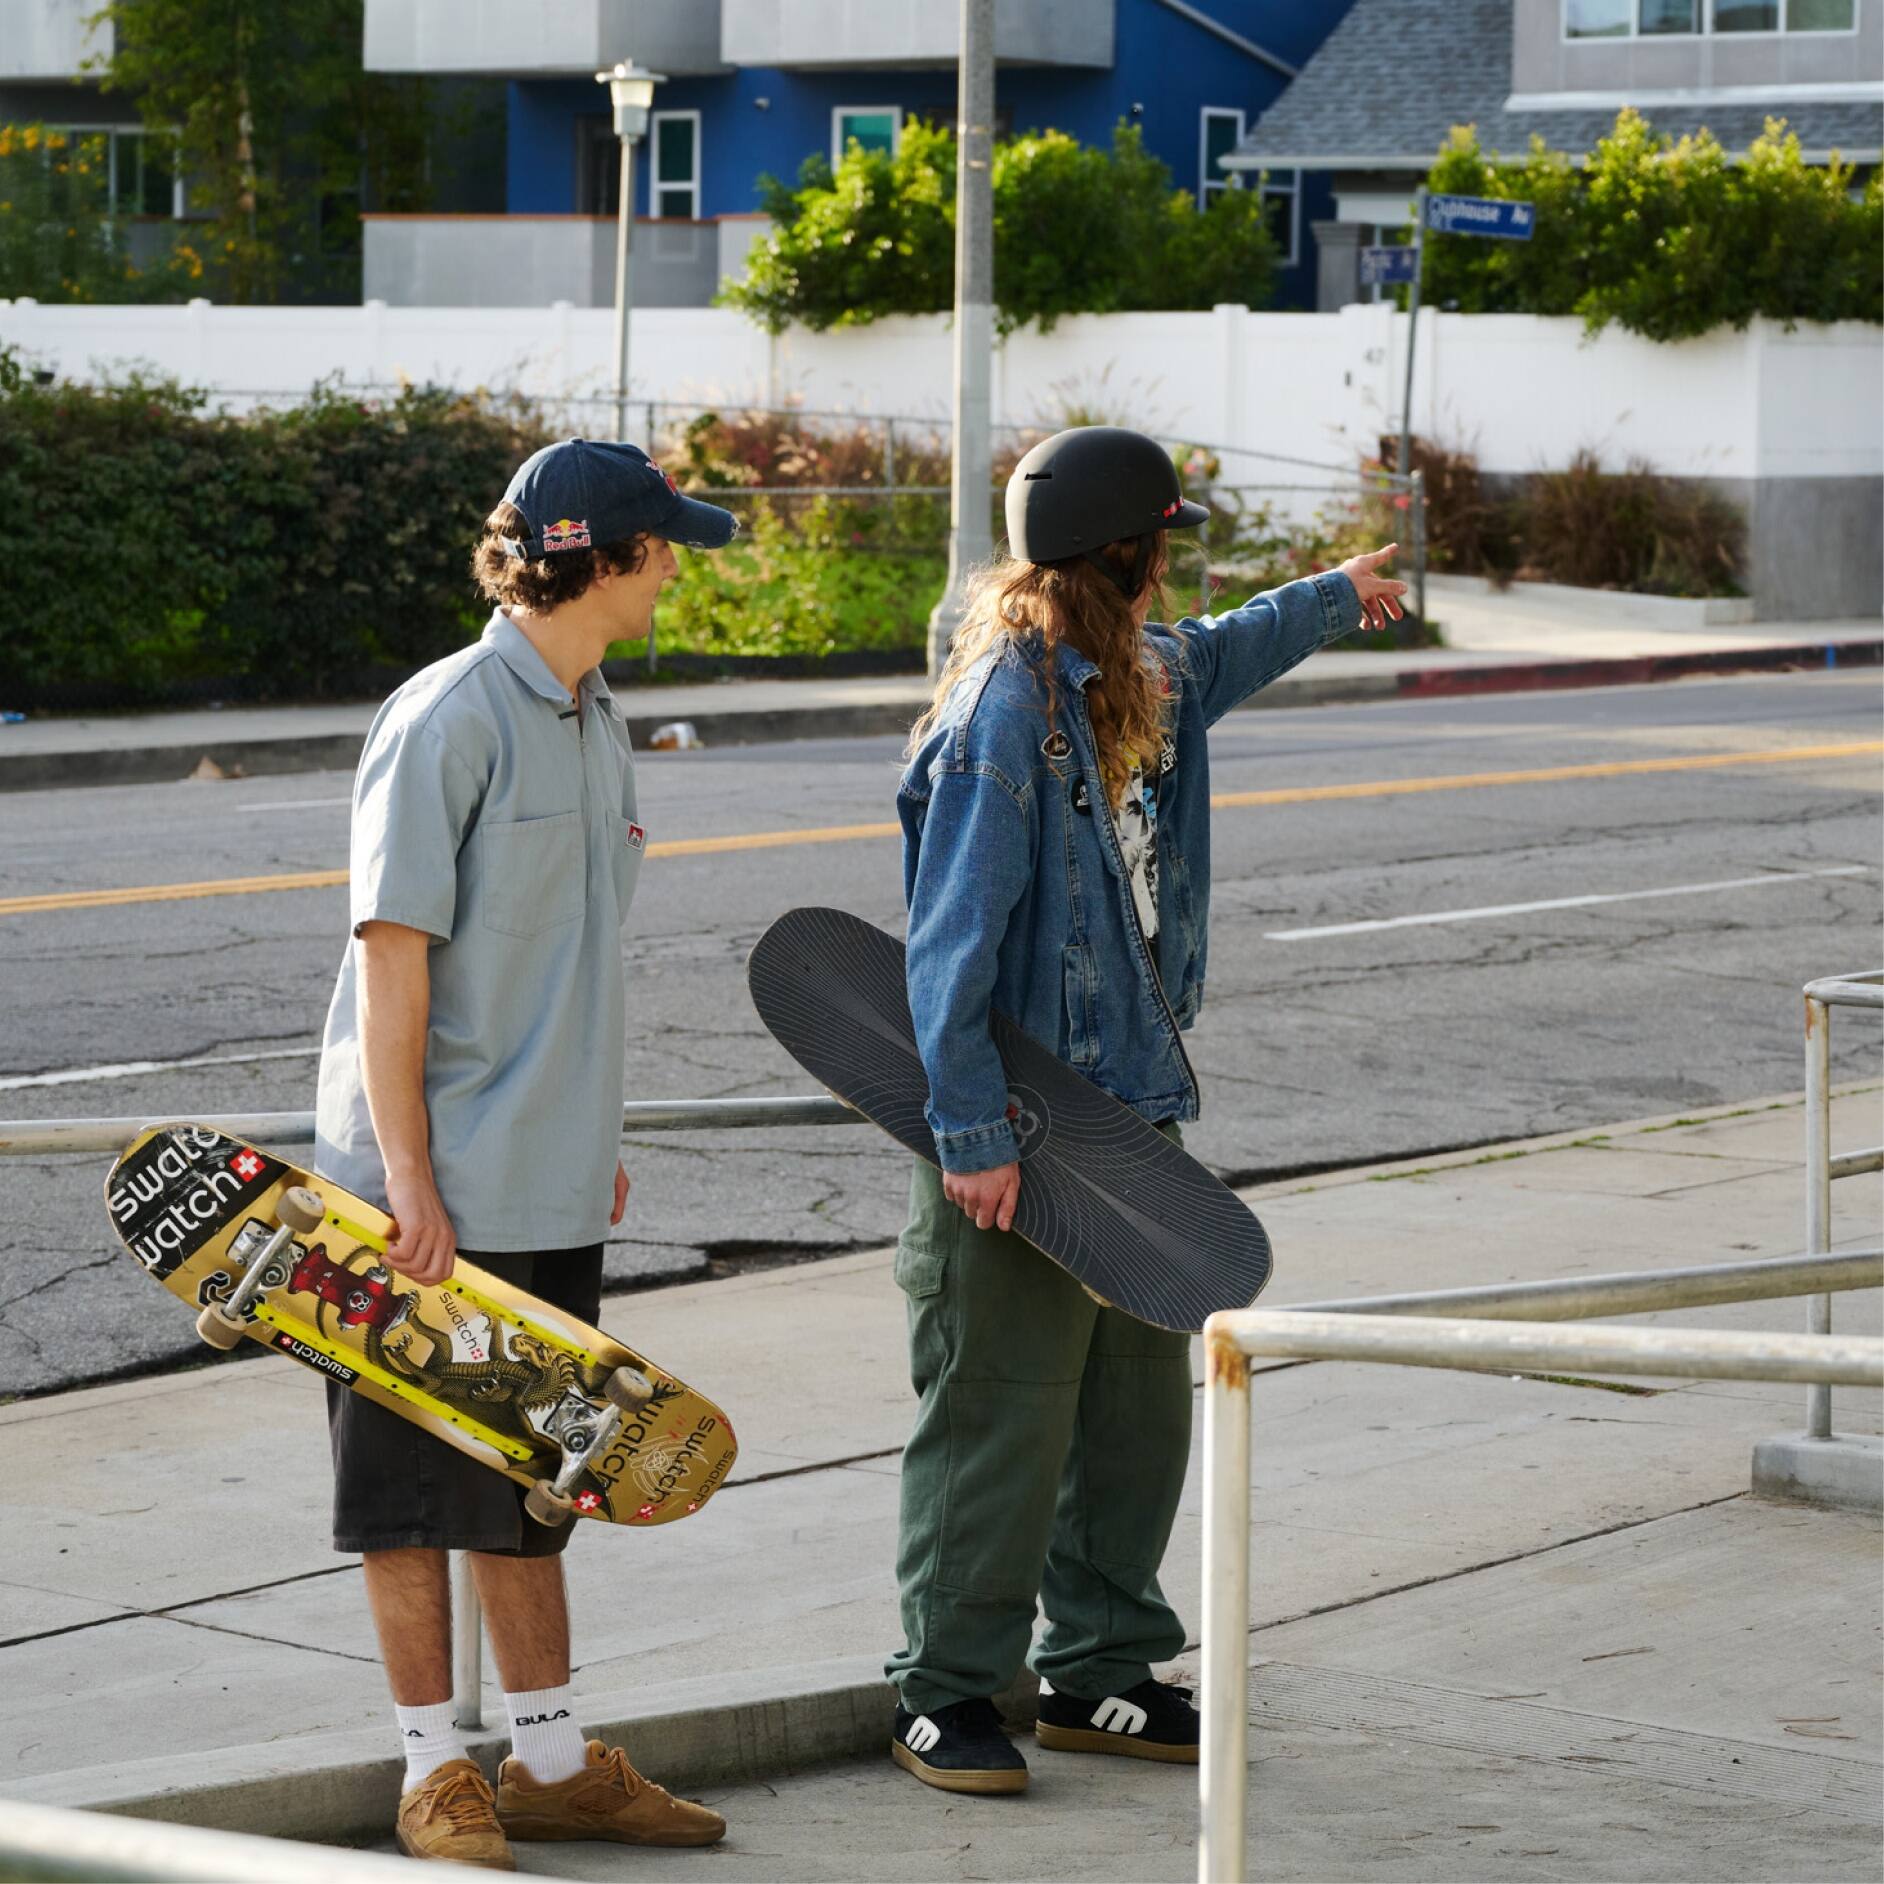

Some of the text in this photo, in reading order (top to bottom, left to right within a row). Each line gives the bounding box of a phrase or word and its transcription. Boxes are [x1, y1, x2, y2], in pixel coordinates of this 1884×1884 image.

[545, 534, 591, 551] Red Bull
[439, 1292, 477, 1350] swatch
[291, 1341, 353, 1380] swatch
[692, 1450, 735, 1503] swatch
[515, 1709, 570, 1726] BULA
